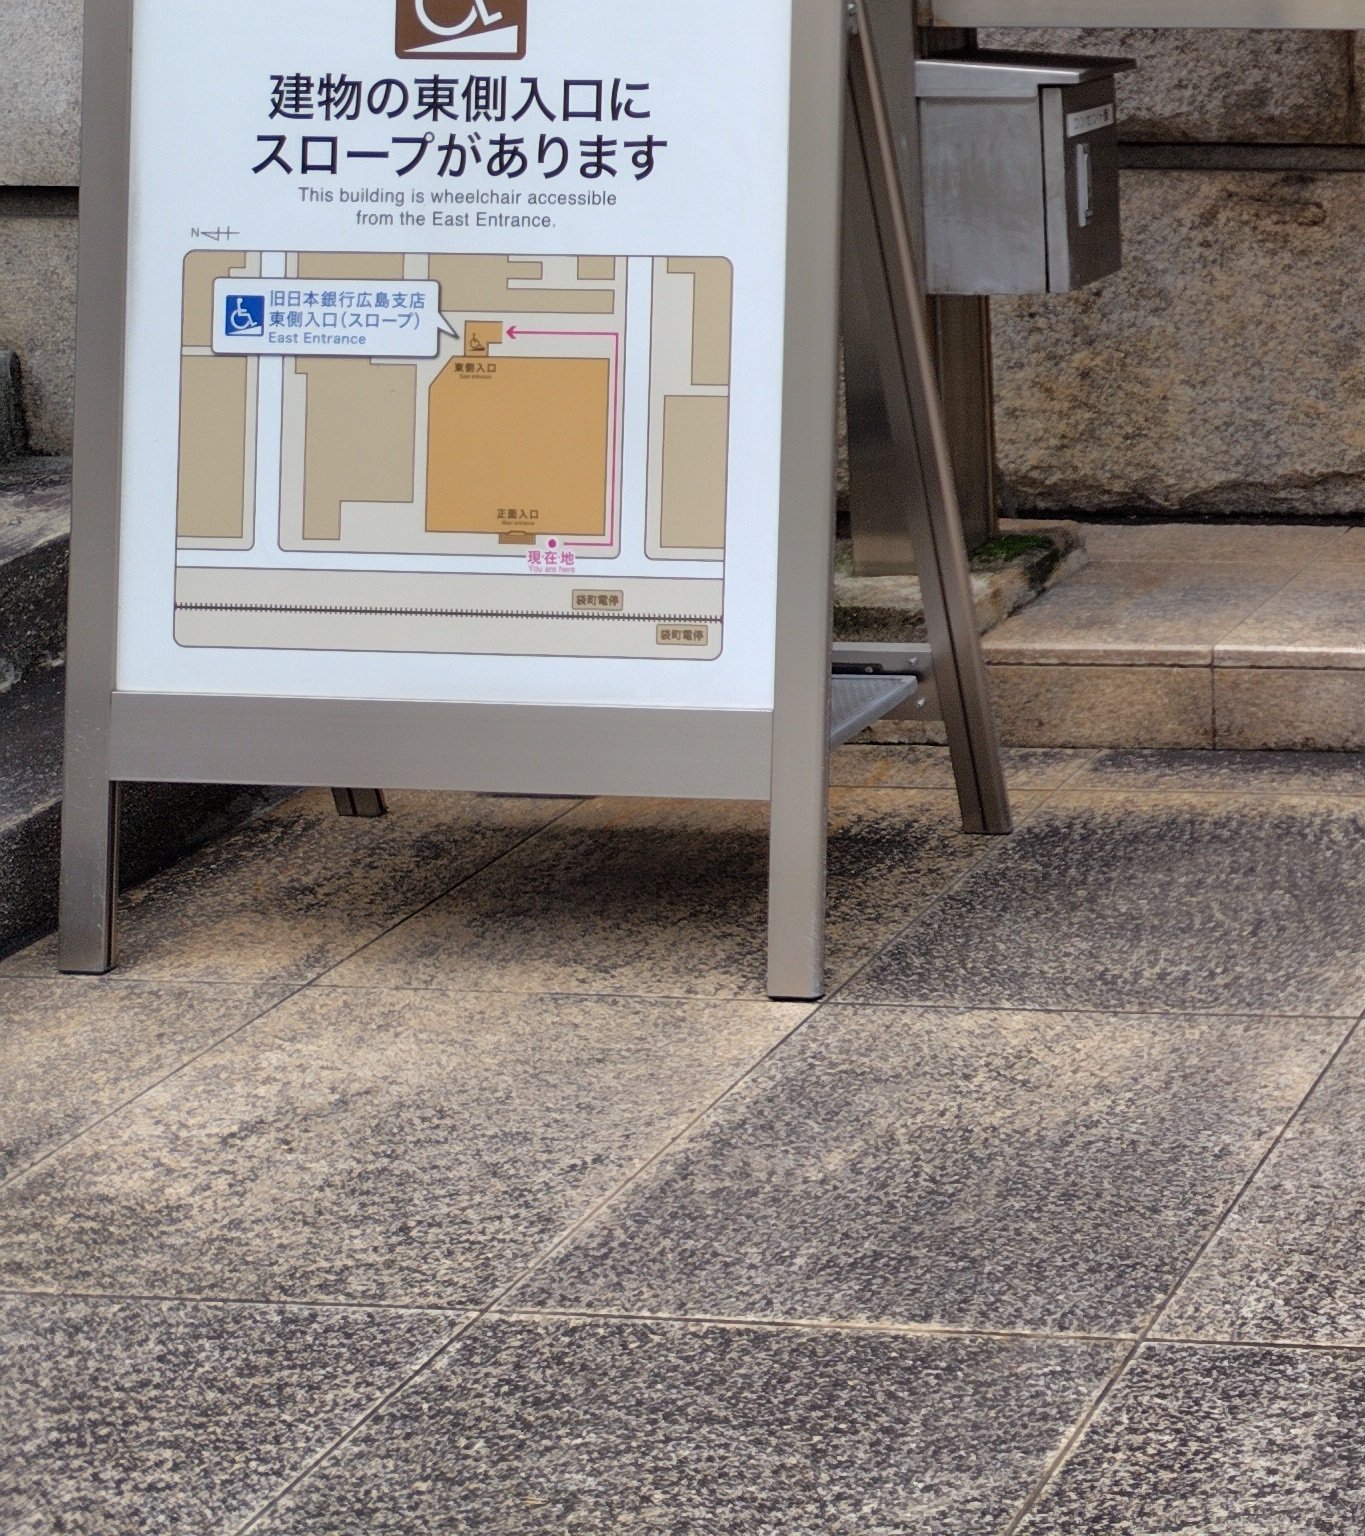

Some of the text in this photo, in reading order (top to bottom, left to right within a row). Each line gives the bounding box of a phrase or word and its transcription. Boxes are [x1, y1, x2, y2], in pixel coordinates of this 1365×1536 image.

[267, 73, 652, 123] 建物の東側入口に
[250, 132, 668, 181] スロープがあります
[298, 187, 617, 210] This building is wheelchair accessible
[356, 210, 557, 230] from the East Entrance.
[268, 289, 427, 310] 旧日本銀行広島支店
[268, 311, 421, 331] 東側入口(スロープ)
[268, 331, 367, 346] East Entrance
[453, 362, 497, 374] 東側入口
[496, 508, 540, 520] 正面入口
[527, 550, 575, 566] 現在地
[528, 564, 576, 575] You are here
[575, 594, 620, 607] 袋町電停
